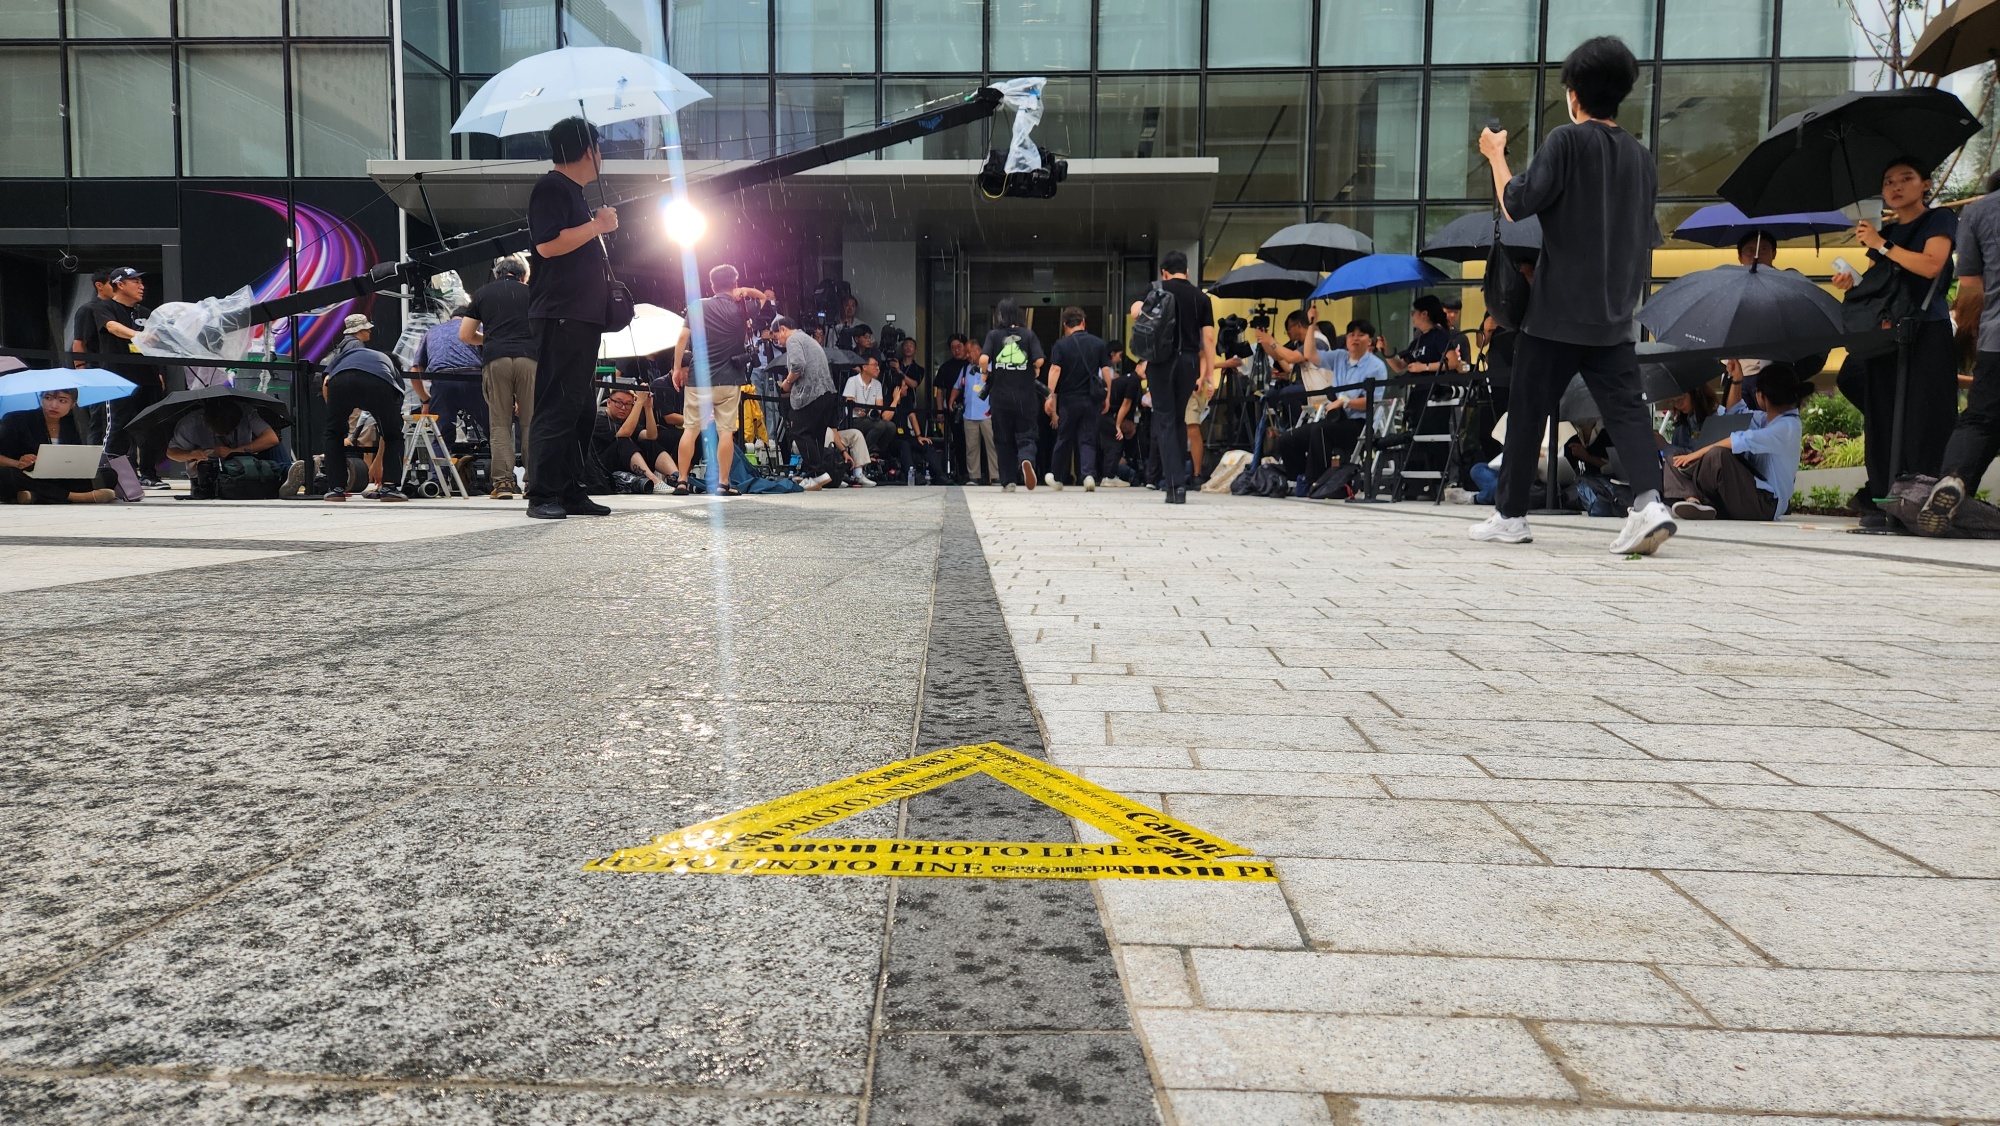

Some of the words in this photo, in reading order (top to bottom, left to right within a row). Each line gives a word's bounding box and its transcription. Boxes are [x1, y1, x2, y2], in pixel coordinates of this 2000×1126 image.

[995, 360, 1028, 370] ACG
[775, 798, 871, 831] PHOTO
[889, 843, 1029, 858] PHOTO
[1040, 845, 1132, 858] LINE
[890, 860, 984, 875] LINE
